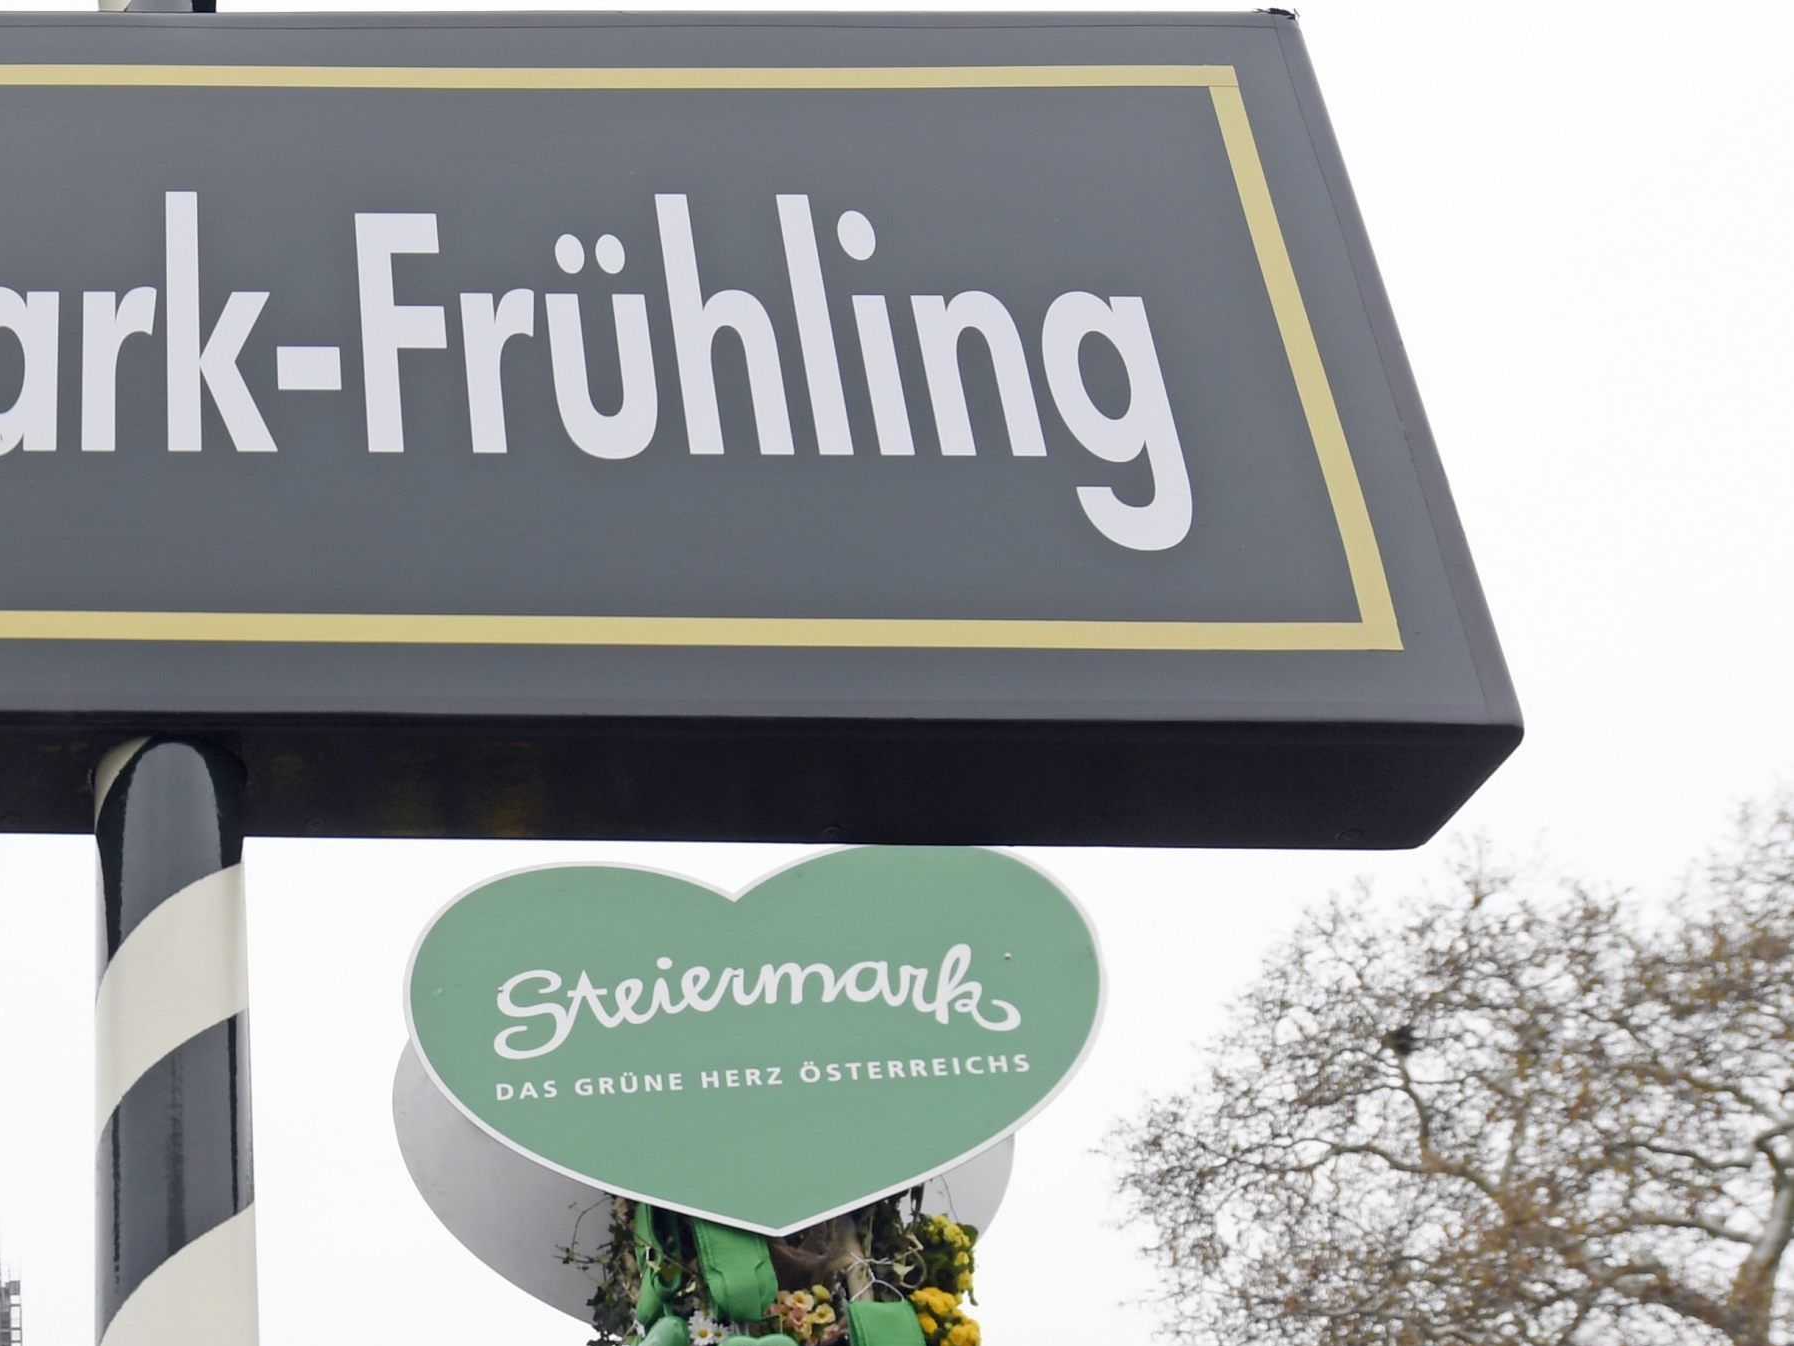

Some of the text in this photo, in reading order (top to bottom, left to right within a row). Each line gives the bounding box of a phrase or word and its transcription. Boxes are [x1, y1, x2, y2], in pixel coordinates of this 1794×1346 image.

[493, 942, 1022, 1060] Steiermark
[495, 1052, 1032, 1102] DAS GRÜNE HERZ ÖSTERREICHS
